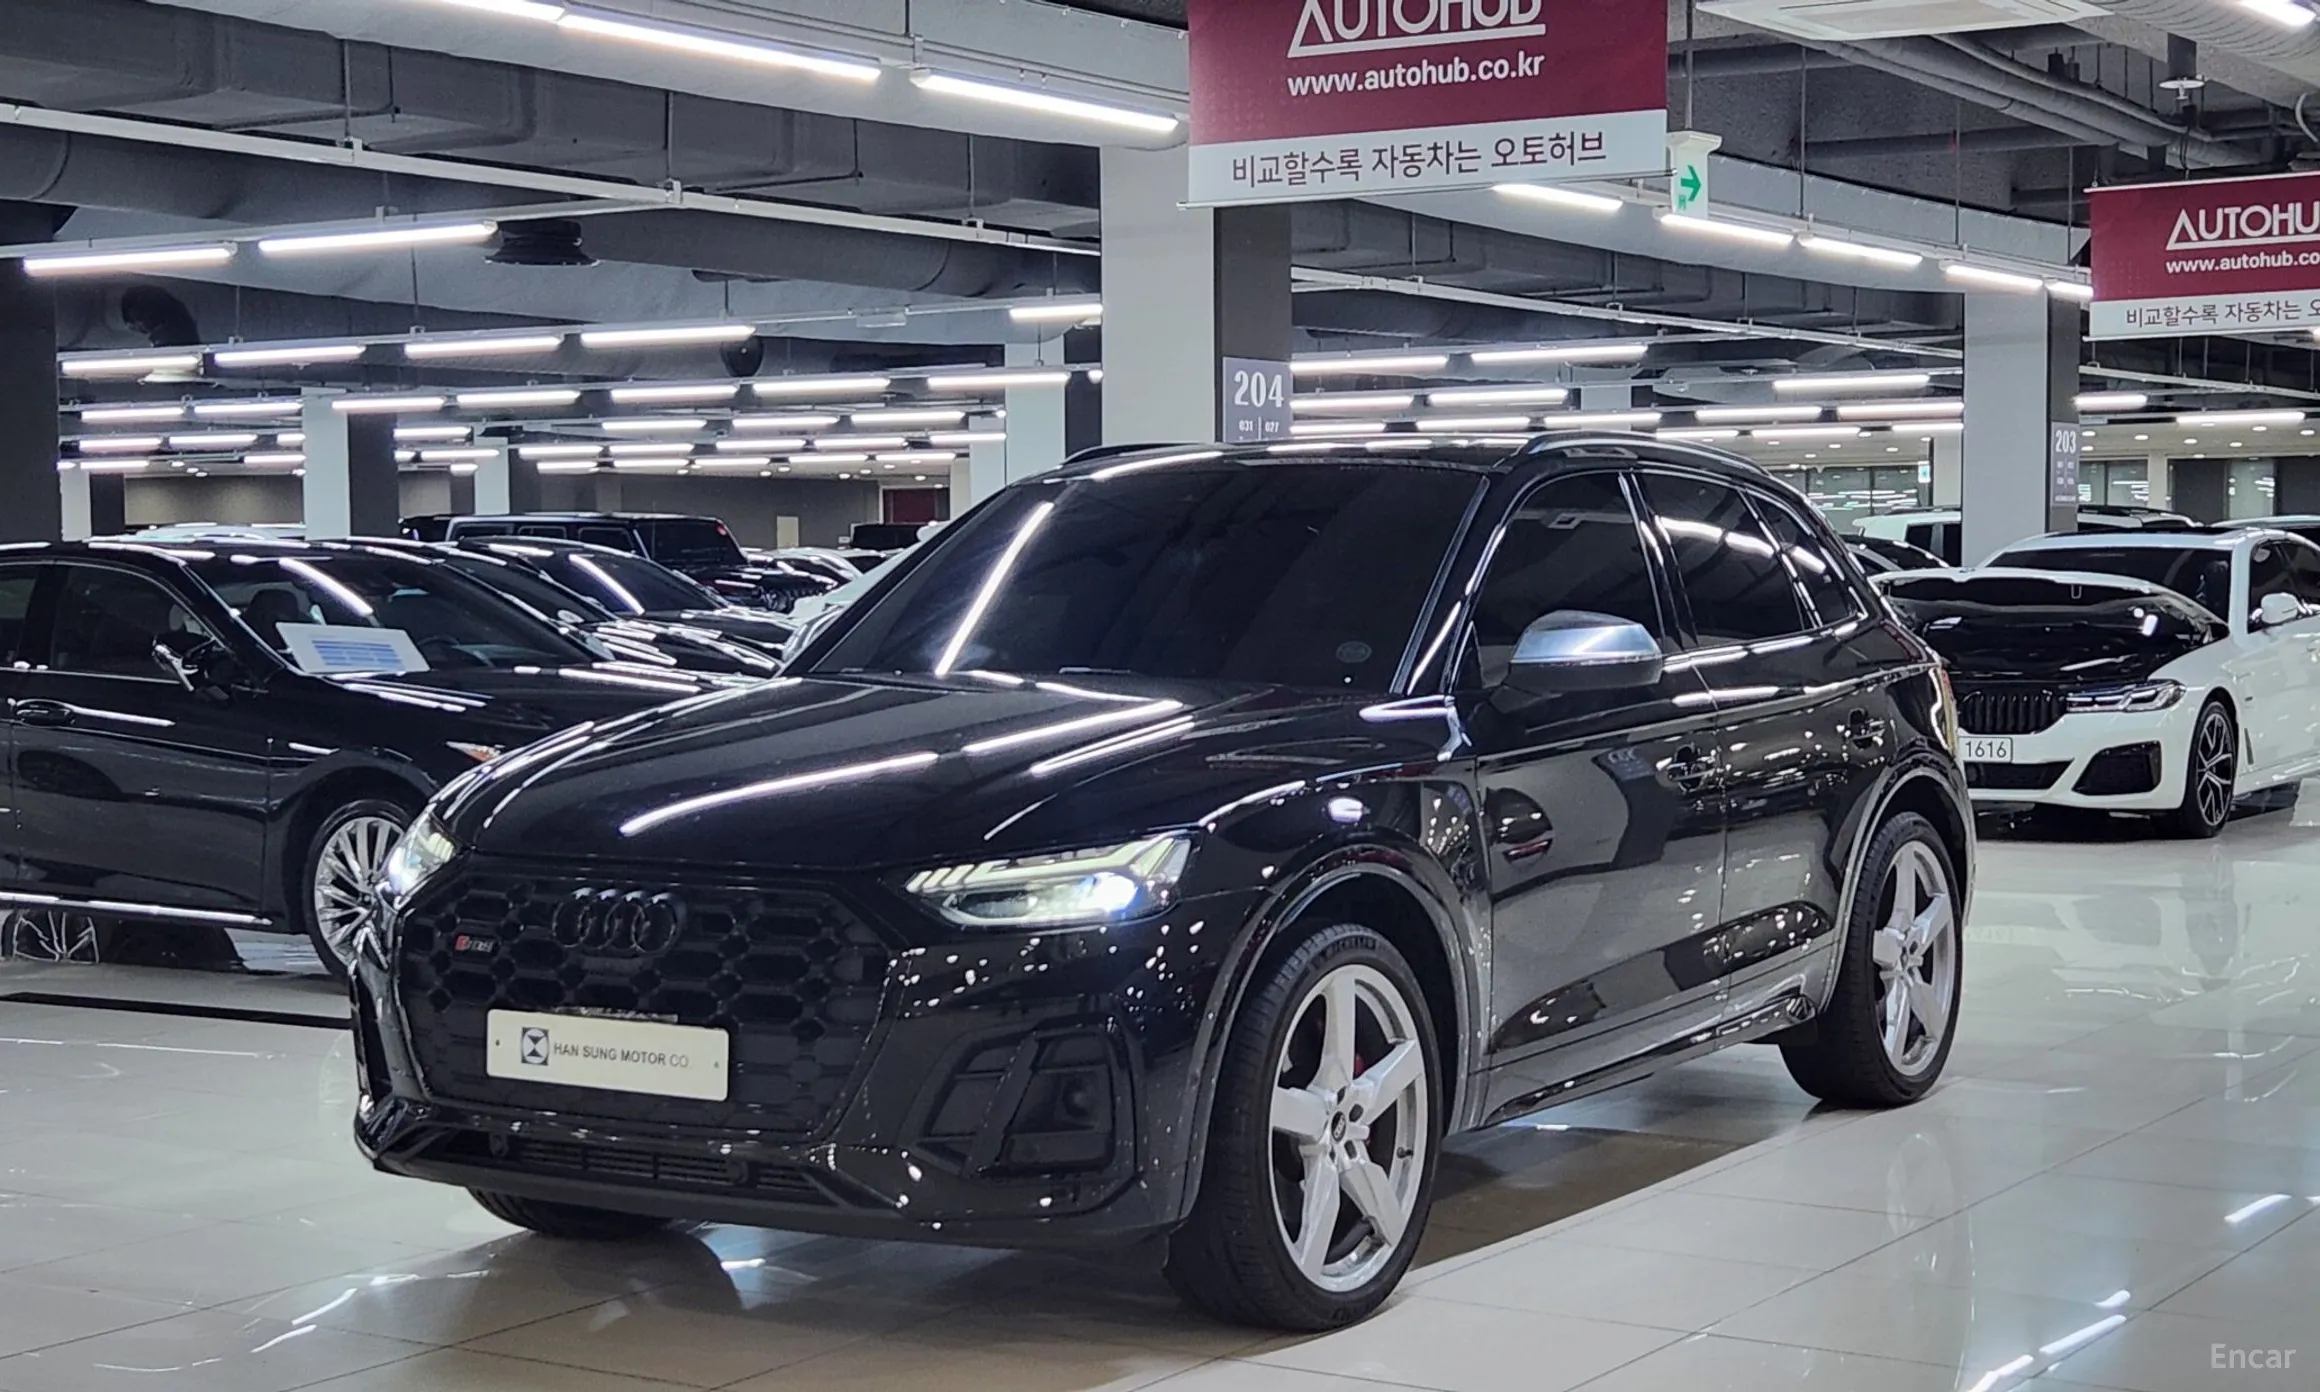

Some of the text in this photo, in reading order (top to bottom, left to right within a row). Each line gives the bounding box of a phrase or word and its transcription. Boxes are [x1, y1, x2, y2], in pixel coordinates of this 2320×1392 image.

[1287, 51, 1545, 97] www.autohub.co.kr
[1232, 131, 1607, 188] 비교할수록 자동차는 오토허브
[2126, 304, 2219, 328] 비교할수록
[2224, 300, 2302, 323] 자동차는
[1234, 370, 1284, 408] 204
[2055, 430, 2077, 454] 203
[1965, 741, 2007, 758] 1616
[553, 1042, 579, 1057] HAN
[582, 1045, 617, 1061] SUNG
[621, 1049, 666, 1066] MOTOR
